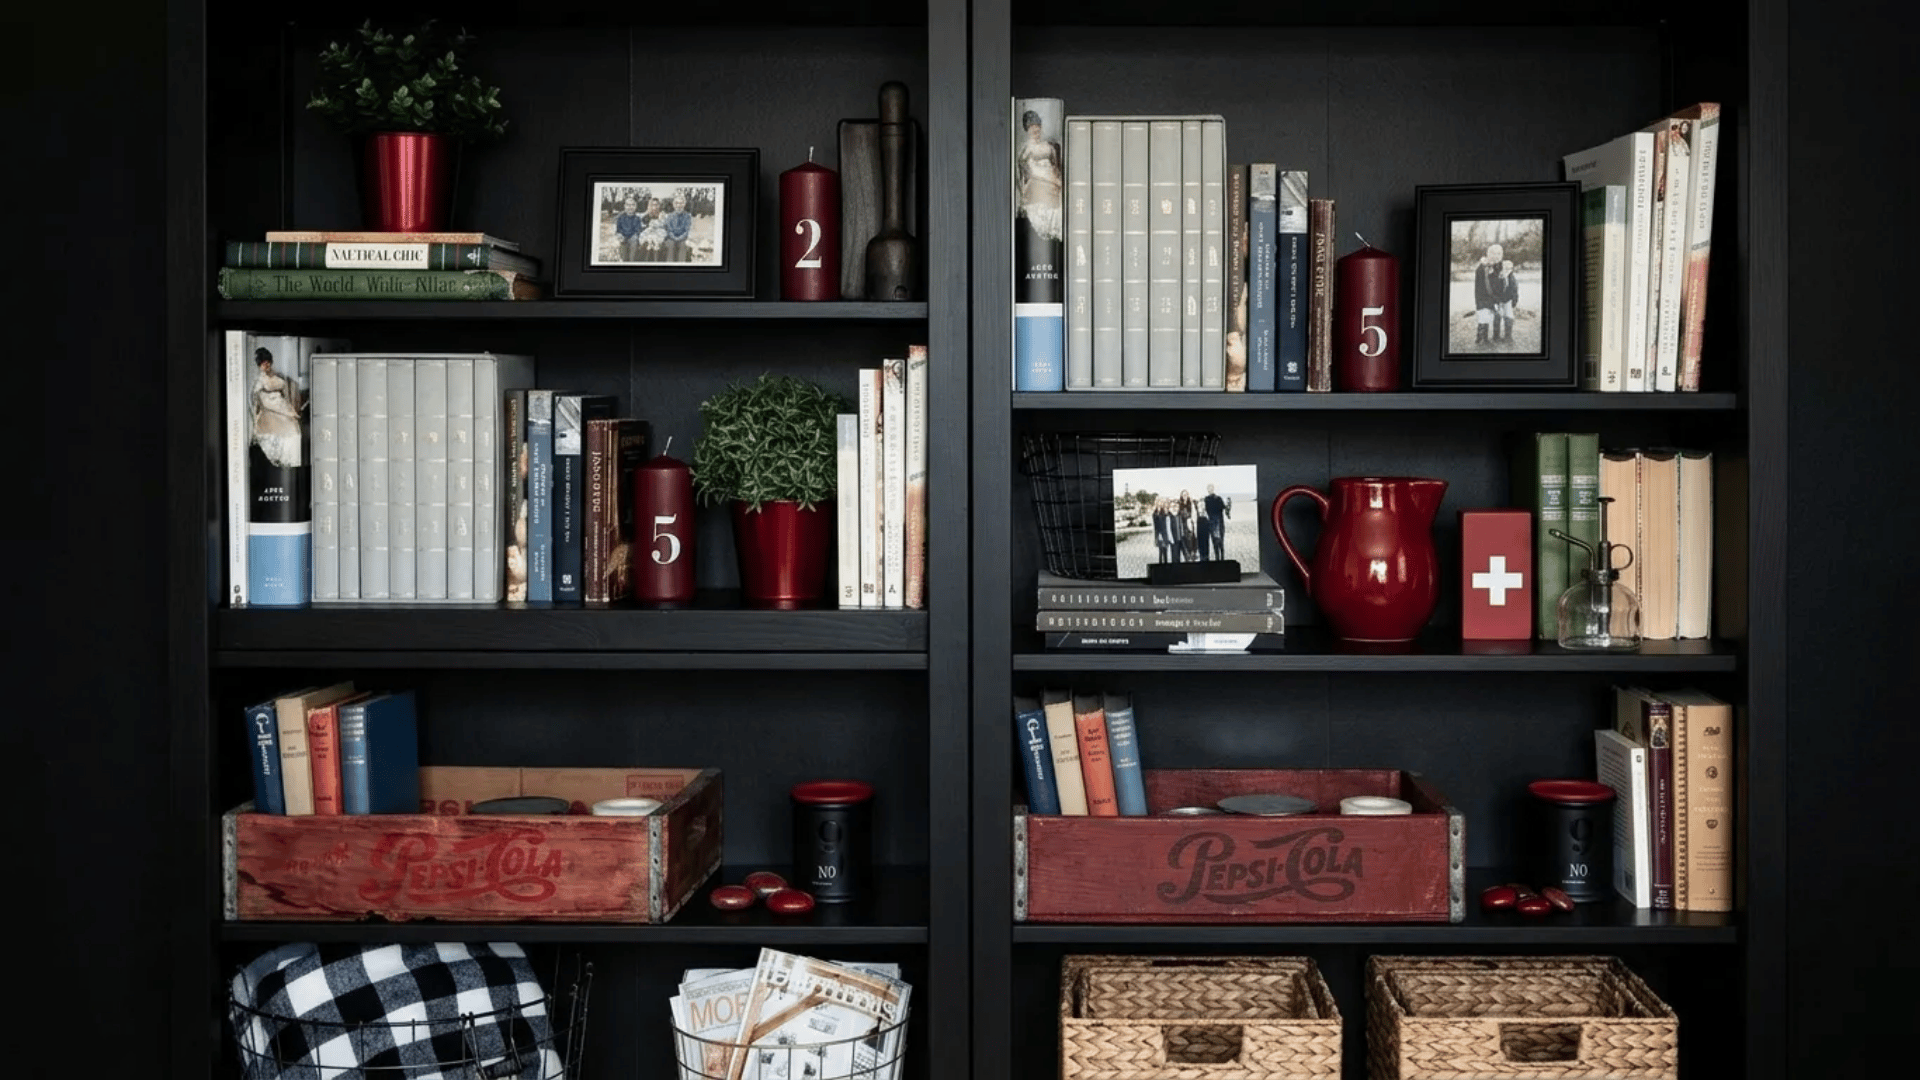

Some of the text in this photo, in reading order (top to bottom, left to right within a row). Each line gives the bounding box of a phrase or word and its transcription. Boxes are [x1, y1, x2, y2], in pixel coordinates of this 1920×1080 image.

[795, 219, 822, 268] 2
[393, 249, 424, 261] CHIC
[273, 275, 303, 293] The
[1359, 305, 1388, 357] 5
[651, 513, 681, 566] 5
[818, 865, 837, 879] NO
[1569, 863, 1588, 877] NO
